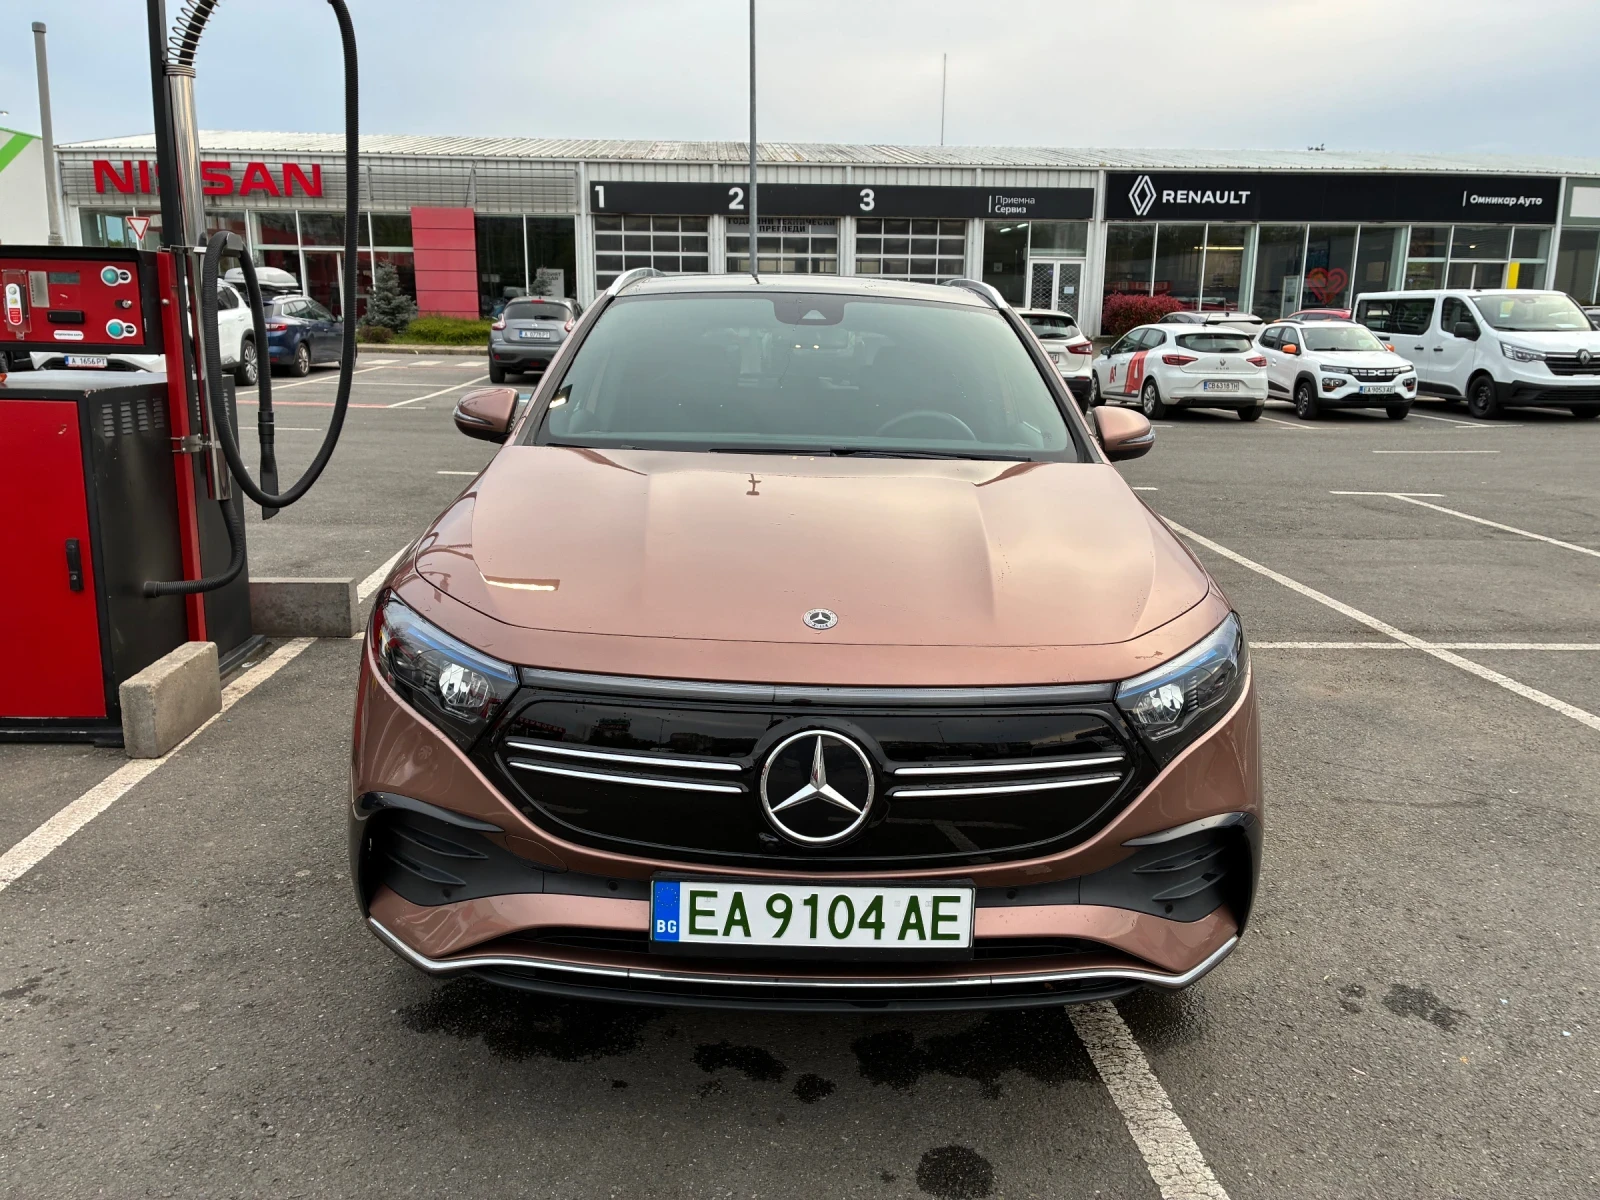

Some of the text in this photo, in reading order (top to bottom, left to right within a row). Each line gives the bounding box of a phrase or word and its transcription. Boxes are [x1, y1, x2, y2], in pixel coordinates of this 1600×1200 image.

[93, 159, 323, 198] NISAN
[594, 185, 605, 208] 1
[728, 187, 745, 210] 2
[859, 188, 875, 211] 3
[995, 195, 1036, 206] Приемна
[1162, 190, 1251, 204] RENAULT
[1470, 195, 1543, 208] Омникар Ауто
[994, 205, 1027, 215] Сервиз
[656, 889, 961, 941] BG EA 9104 AE
